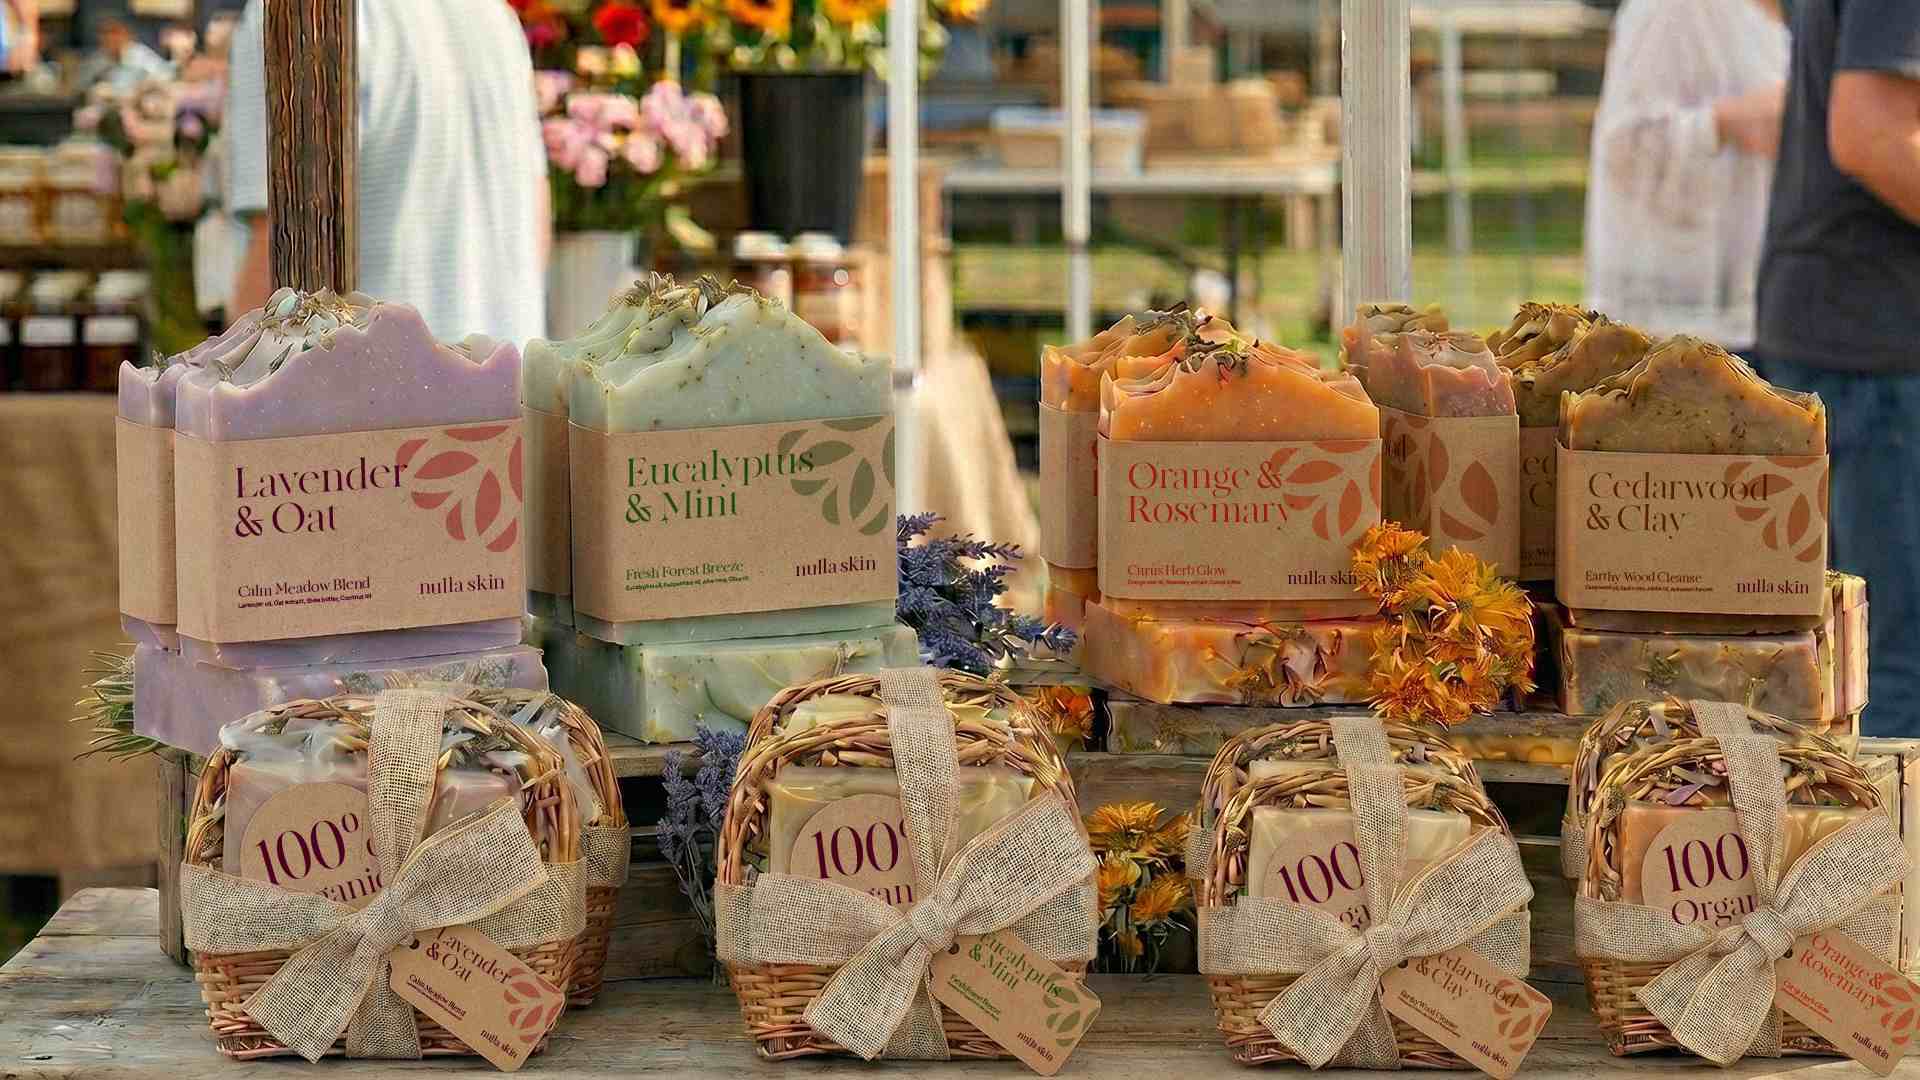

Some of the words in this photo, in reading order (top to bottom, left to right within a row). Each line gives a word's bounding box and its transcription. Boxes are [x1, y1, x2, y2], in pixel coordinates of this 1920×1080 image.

[234, 457, 408, 499] Lavender
[627, 449, 814, 488] Eucalyptus
[1128, 461, 1250, 499] Orange
[1257, 459, 1283, 490] &
[1588, 471, 1769, 502] Cedarwood
[234, 504, 264, 538] &
[272, 501, 338, 535] Oat
[625, 492, 652, 524] &
[661, 484, 739, 524] Mint
[1128, 495, 1291, 531] Rosemary
[1586, 503, 1611, 531] &
[1617, 503, 1688, 540] Clay
[419, 575, 464, 596] nulla
[466, 573, 506, 593] skin
[625, 567, 660, 581] Fresh
[662, 564, 700, 578] Forest
[702, 561, 744, 575] Breeze
[795, 557, 838, 578] nulla
[839, 555, 877, 574] skin
[1166, 563, 1195, 577] Herb
[1196, 563, 1225, 577] Glow
[1287, 568, 1326, 586] nulla
[1584, 570, 1622, 585] Earthy
[1623, 570, 1656, 584] Wood
[1656, 571, 1703, 584] Cleanse
[238, 584, 273, 599] Calm
[275, 580, 331, 597] Meadow
[333, 575, 371, 592] Blend
[1736, 579, 1775, 595] nulla
[1776, 579, 1809, 596] skin
[1277, 841, 1365, 904] 100
[1663, 832, 1749, 892] 100
[1671, 895, 1755, 927] Orga
[426, 942, 440, 961] &
[442, 953, 472, 983] Oat
[437, 926, 513, 984] Lavender
[969, 943, 982, 962] &
[983, 954, 1020, 990] Mint
[1811, 931, 1865, 980] Orange
[1869, 971, 1884, 991] &
[1416, 958, 1430, 977] &
[1431, 968, 1465, 1000] Clay
[1438, 953, 1520, 1008] edarwood
[1800, 949, 1878, 1010] Rosemary
[480, 1029, 501, 1048] nulla
[500, 1043, 519, 1059] skin
[1017, 1031, 1040, 1051] nulla
[1038, 1046, 1054, 1062] skin
[1471, 1040, 1491, 1057] nulla
[1491, 1052, 1509, 1068] skin
